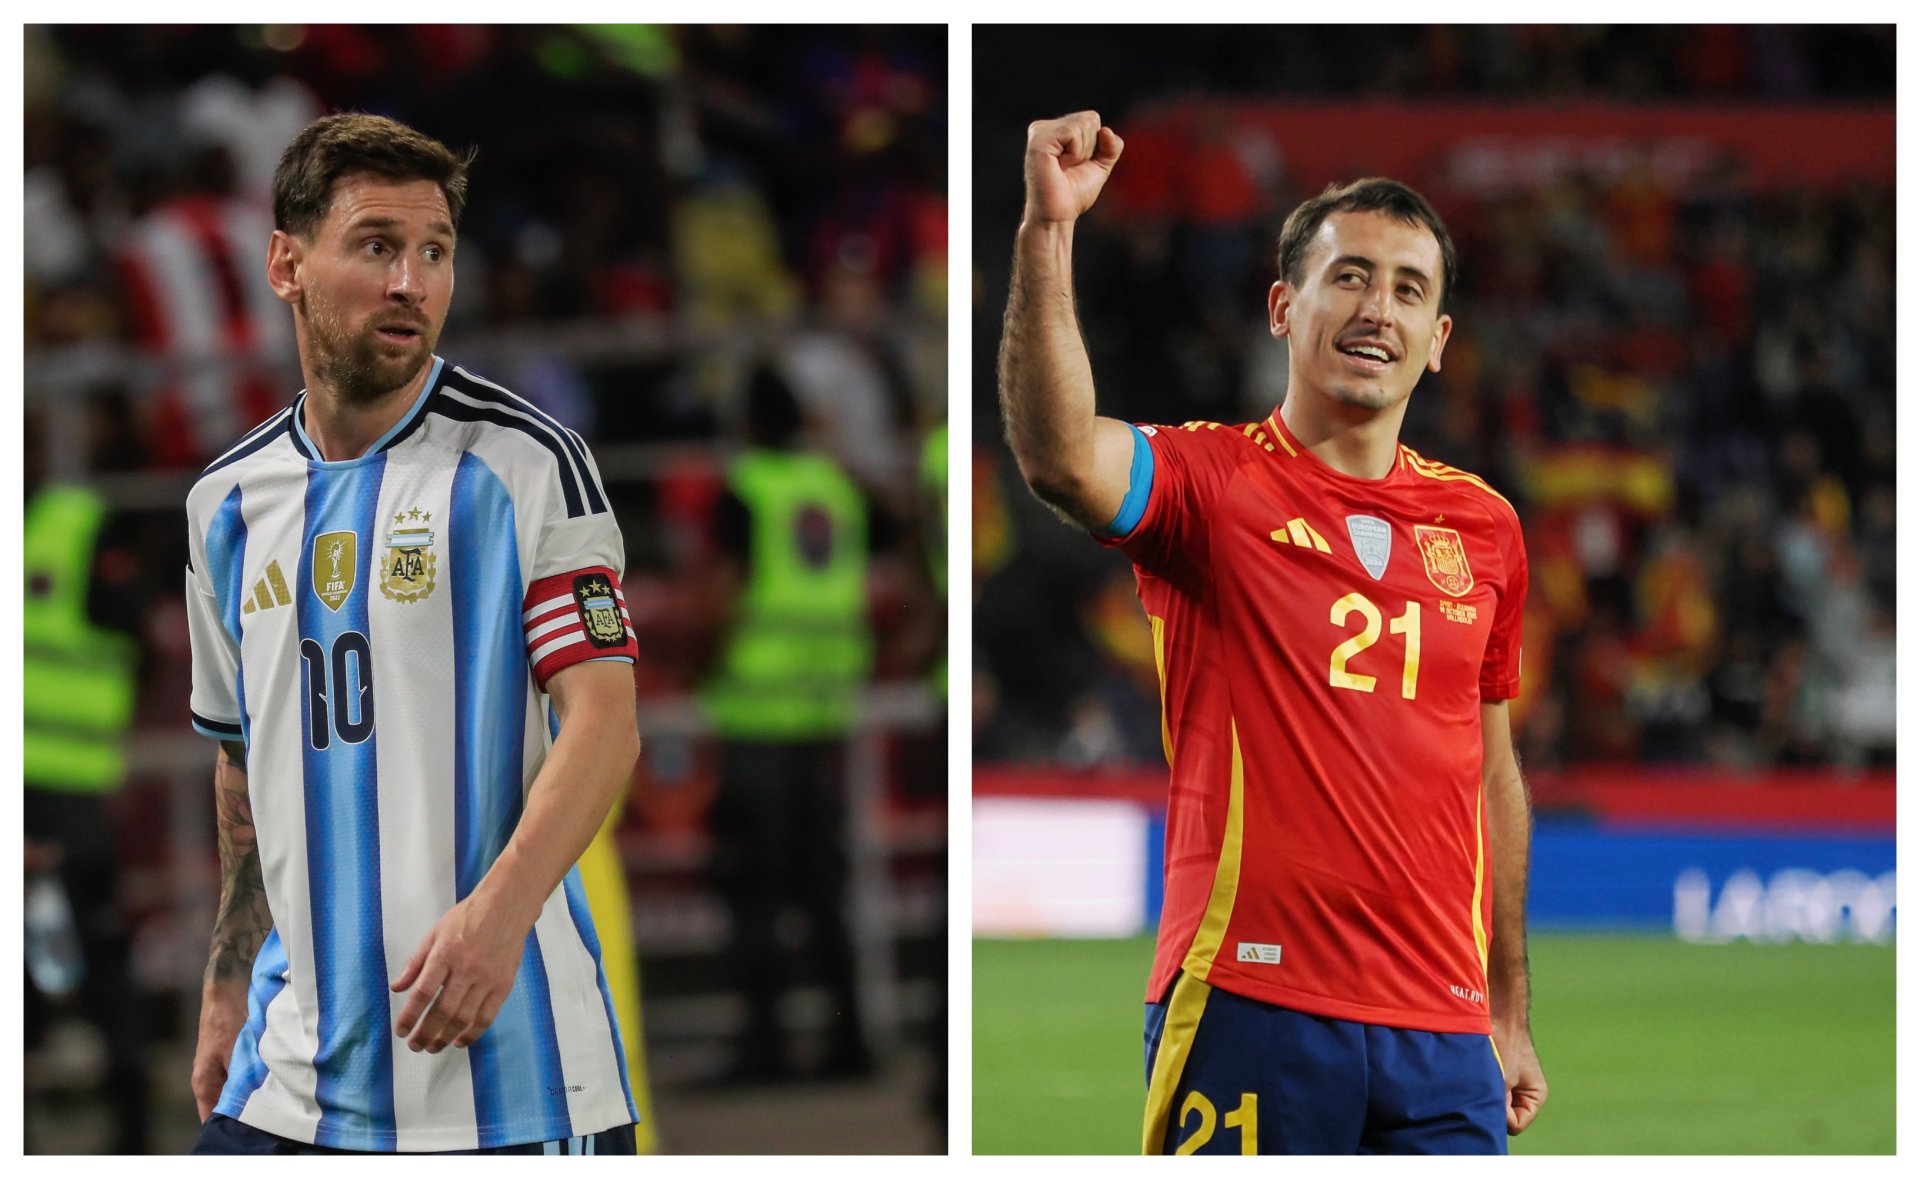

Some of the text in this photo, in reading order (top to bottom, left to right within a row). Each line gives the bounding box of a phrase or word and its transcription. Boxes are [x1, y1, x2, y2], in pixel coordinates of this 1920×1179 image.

[326, 580, 345, 592] FIFA
[391, 548, 424, 582] AFA
[595, 608, 616, 629] AFA
[1329, 592, 1421, 700] 21
[300, 630, 375, 751] 10
[1175, 1090, 1258, 1156] 21
